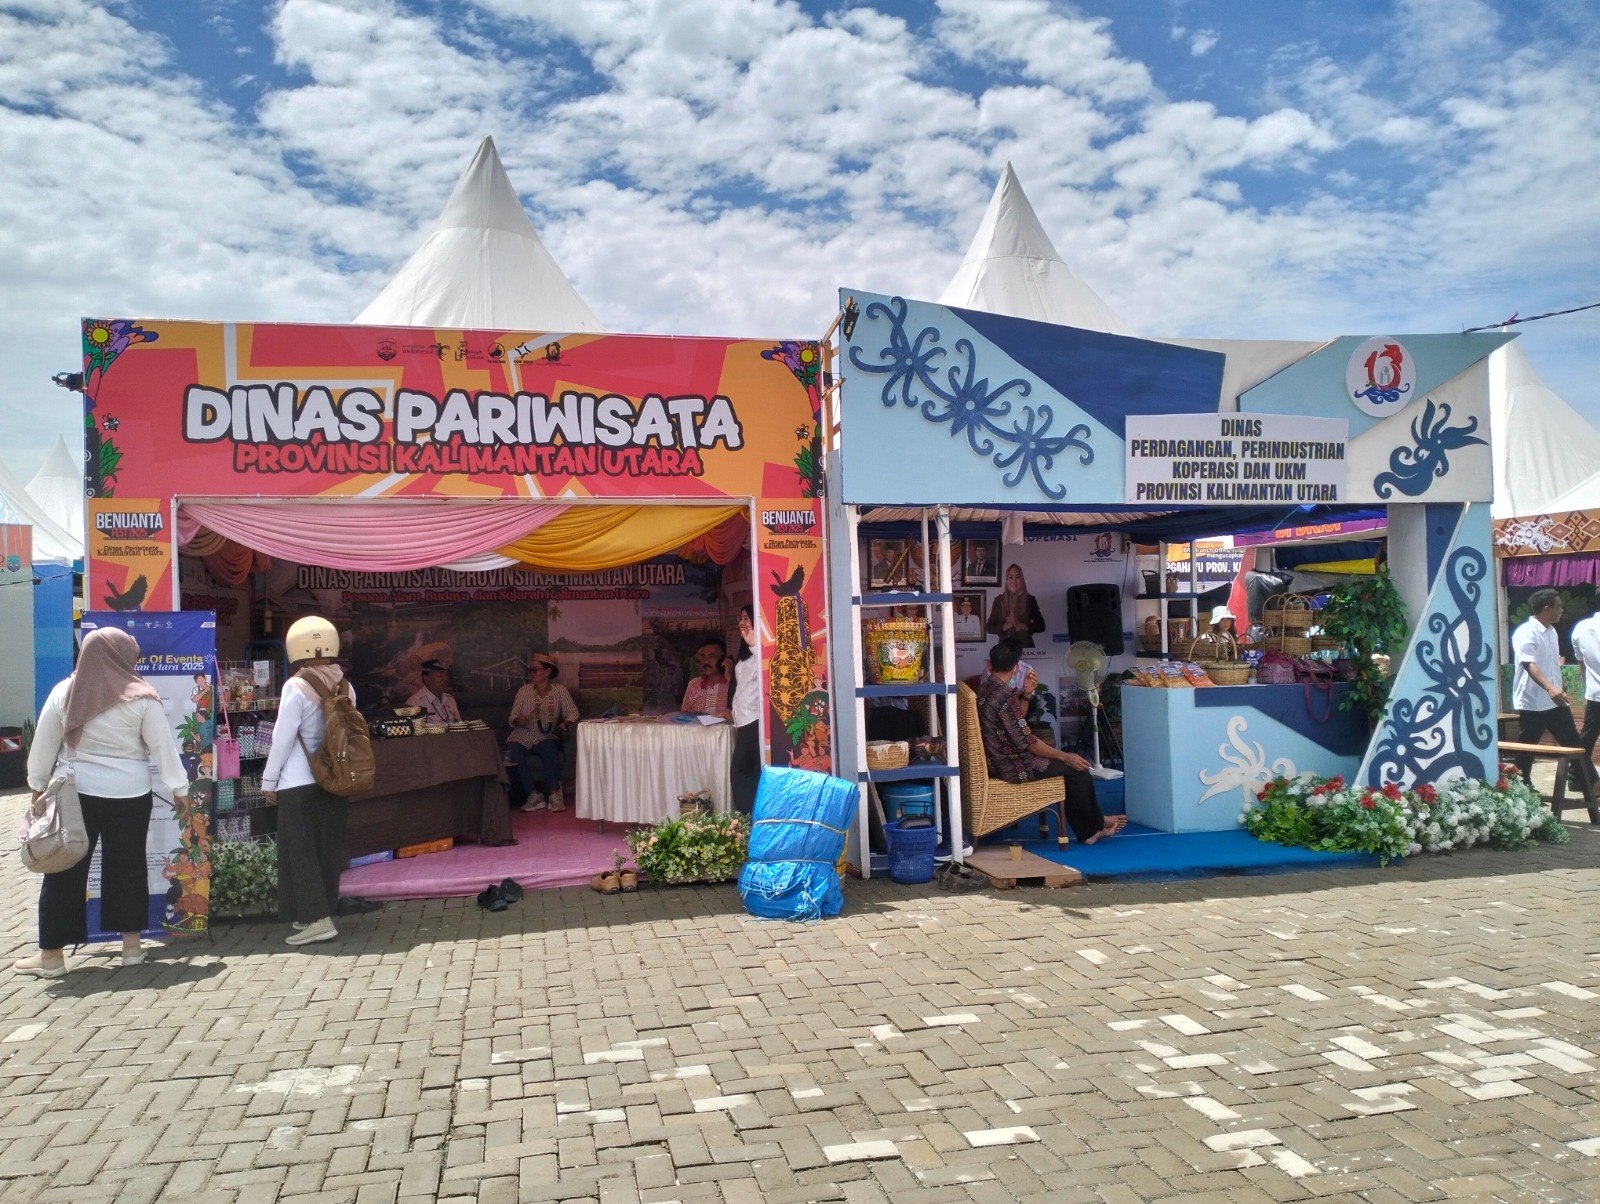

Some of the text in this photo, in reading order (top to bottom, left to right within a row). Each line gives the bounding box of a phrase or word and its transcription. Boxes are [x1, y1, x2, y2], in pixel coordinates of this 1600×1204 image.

[184, 384, 743, 449] DINAS PARIWISATA
[1221, 419, 1262, 437] DINAS
[235, 442, 703, 475] PROVINSI KALIMANTAN UTARA
[1131, 440, 1345, 460] PERDAGANGAN, PERINDUSTRIAN
[1172, 461, 1306, 480] KOPERASI DAN UKM
[1136, 482, 1337, 501] PROVINSI KALIMANTAN UTARA
[96, 513, 164, 529] BENUANTA
[762, 510, 816, 525] BENUANTA
[112, 528, 127, 538] FEST
[1206, 561, 1231, 573] PROV.
[299, 566, 350, 589] DINAS
[353, 570, 451, 589] PARIWISATA
[638, 564, 686, 585] UTARA
[499, 588, 543, 602] Sejarah
[545, 588, 614, 600] Kalimantan
[615, 588, 650, 600] Utara
[149, 654, 163, 664] Of
[165, 654, 203, 664] Events
[152, 663, 179, 671] Utara
[181, 662, 204, 671] 2025
